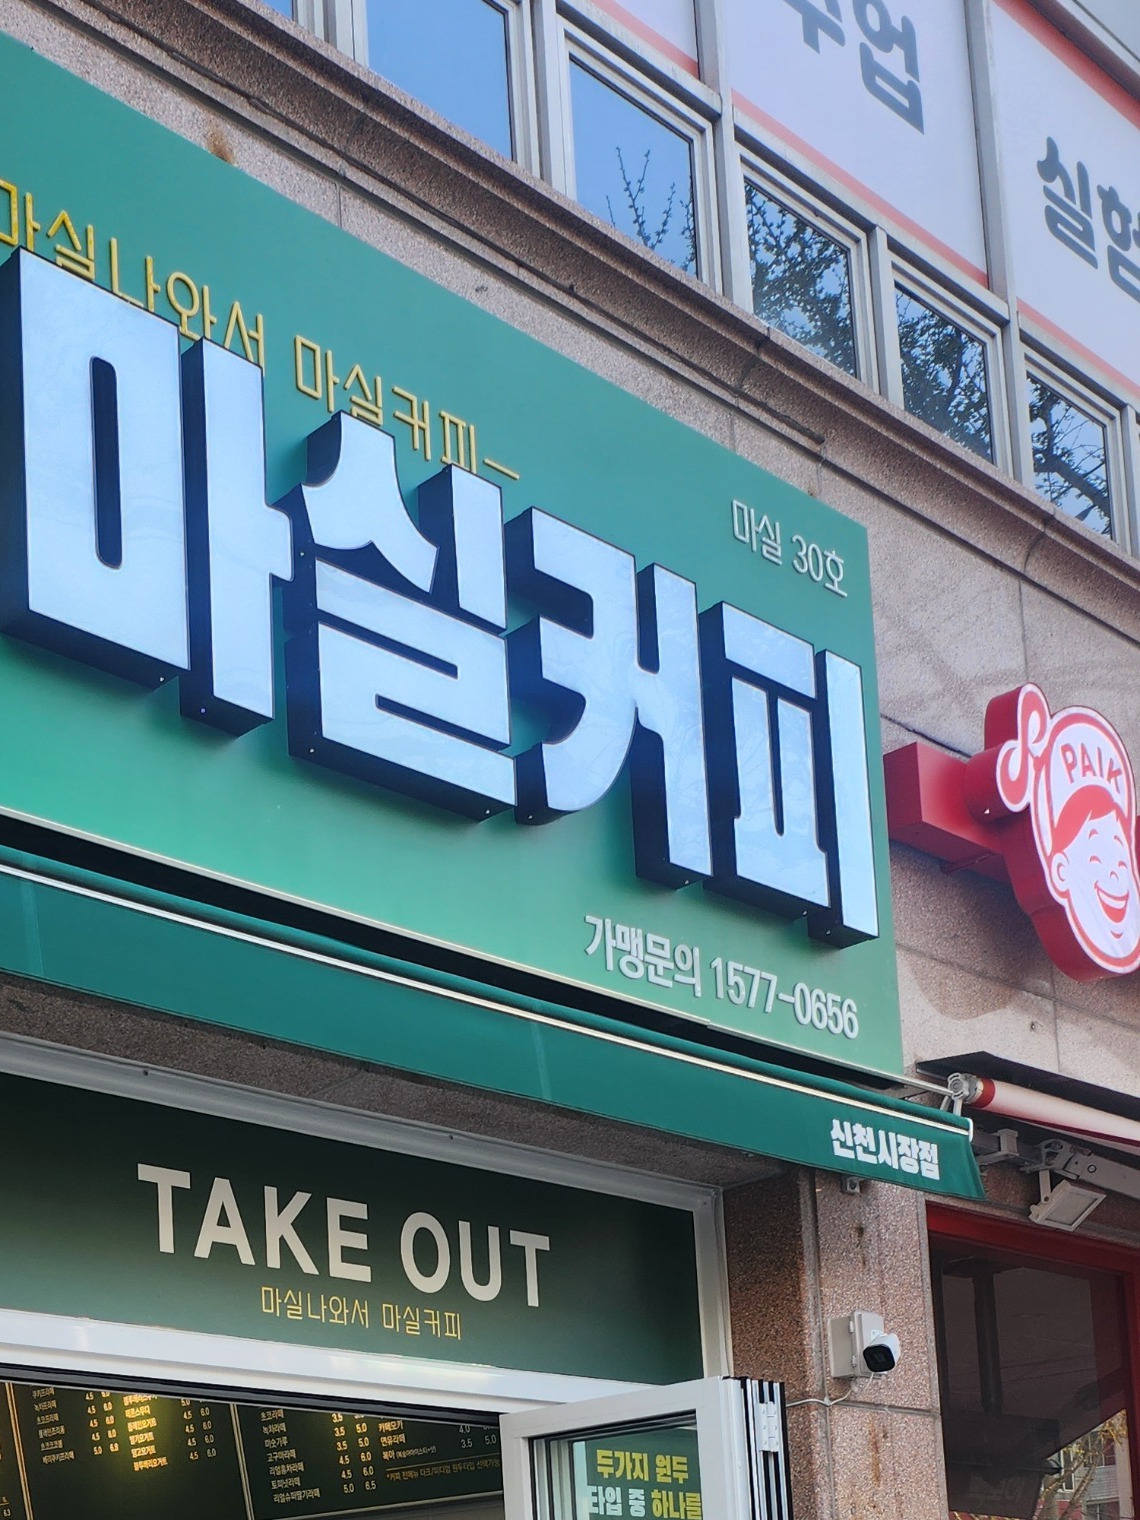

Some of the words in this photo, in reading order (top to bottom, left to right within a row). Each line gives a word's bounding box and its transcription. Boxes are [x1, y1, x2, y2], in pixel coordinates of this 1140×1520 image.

[732, 499, 783, 566] 마실
[791, 534, 848, 598] 30호
[15, 246, 879, 939] 마실커피
[1060, 742, 1123, 795] PAIK
[584, 915, 702, 998] 가맹문의
[708, 957, 860, 1040] 1577-0656
[830, 1118, 941, 1181] 신천시장점
[136, 1162, 372, 1283] TAKE
[400, 1211, 551, 1308] OUT
[261, 1286, 370, 1329] 마실나와서
[382, 1303, 462, 1341] 마실커피
[460, 1439, 473, 1449] 3.5
[484, 1435, 497, 1446] 5.0
[596, 1449, 649, 1482] 두가지
[655, 1452, 689, 1484] 원두
[365, 1480, 377, 1491] 6.5
[628, 1488, 646, 1518] 중
[651, 1490, 703, 1520] 하나를
